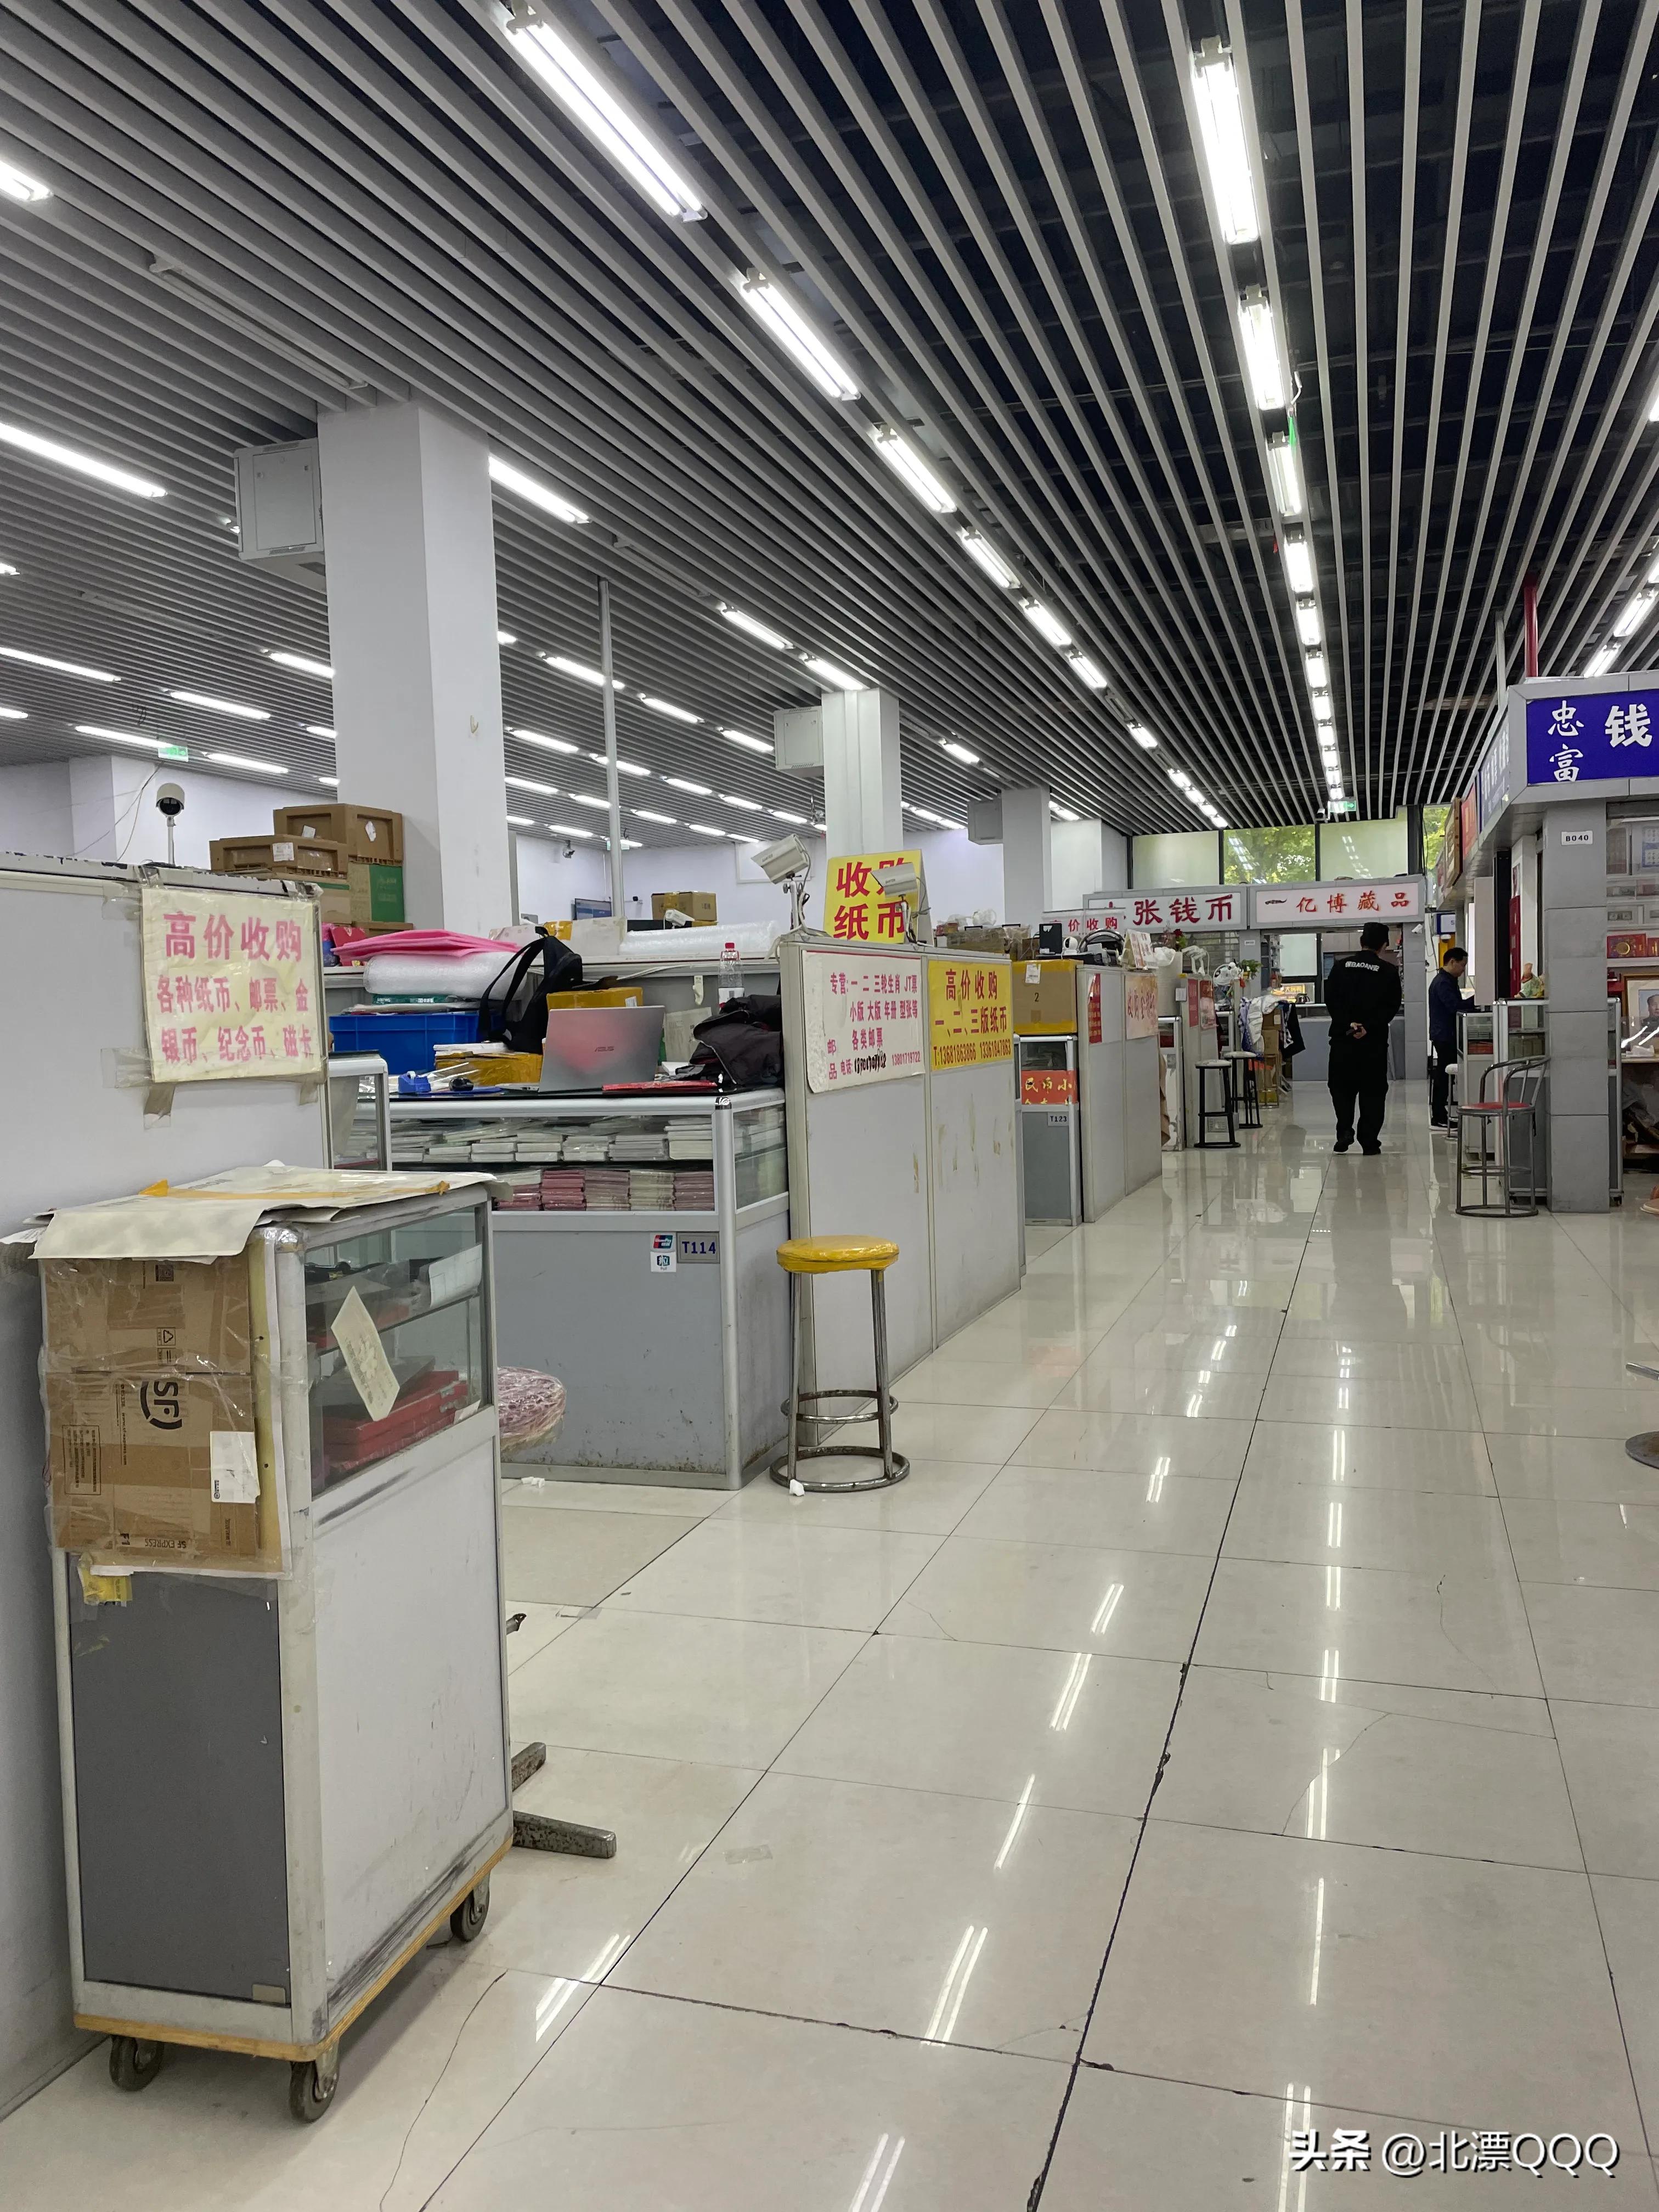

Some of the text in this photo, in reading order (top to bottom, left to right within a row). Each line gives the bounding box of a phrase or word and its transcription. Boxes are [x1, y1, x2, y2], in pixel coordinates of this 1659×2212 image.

[1548, 699, 1584, 782] 忠富
[1605, 703, 1652, 748] 钱
[833, 901, 905, 940] 纸币
[1050, 917, 1118, 932] 价收购
[1109, 894, 1233, 926] 张钱币
[163, 911, 302, 962] 高价收购
[945, 968, 997, 1001] 高价收购
[1034, 992, 1039, 1002] 2
[852, 1027, 883, 1051] 各类邮票
[682, 1241, 716, 1254] T114
[145, 1538, 175, 1549] EXPRESS
